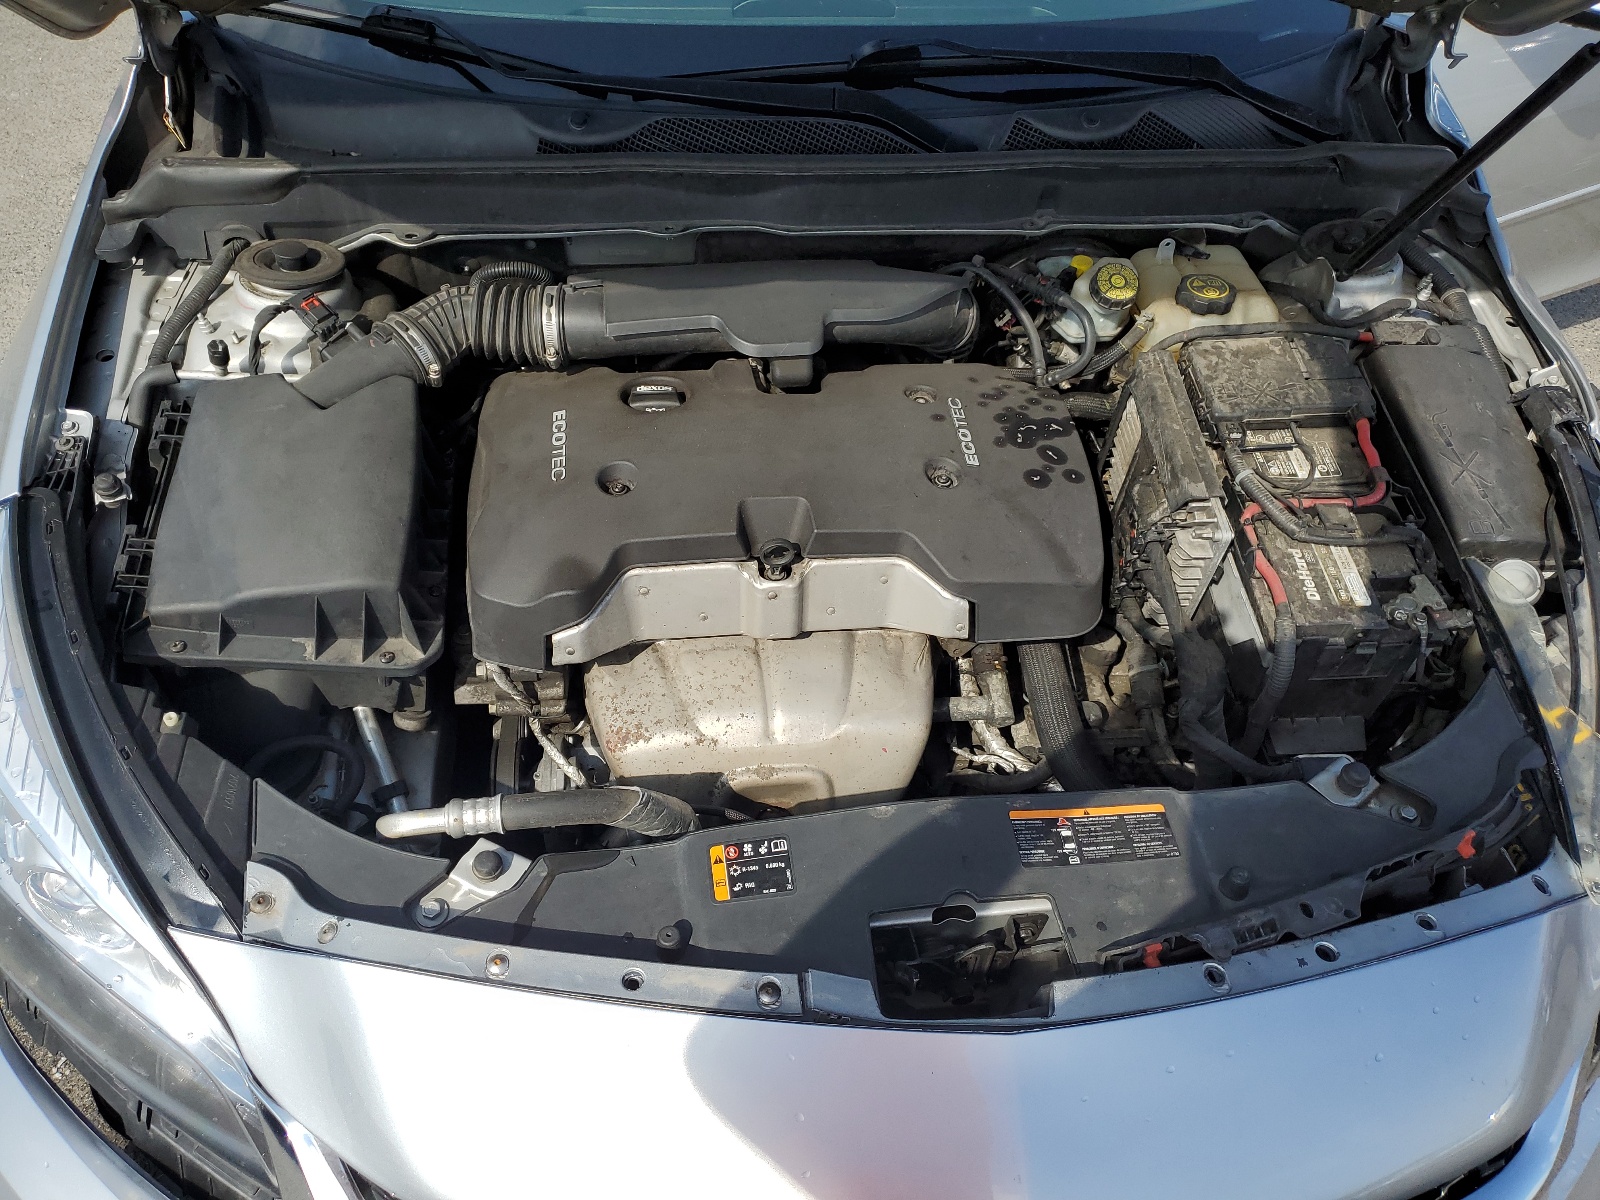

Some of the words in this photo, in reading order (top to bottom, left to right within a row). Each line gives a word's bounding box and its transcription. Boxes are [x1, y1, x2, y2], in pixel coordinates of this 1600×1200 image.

[551, 409, 567, 482] ECOTEC
[948, 397, 980, 466] ECOTEC
[1287, 548, 1321, 601] DieHard
